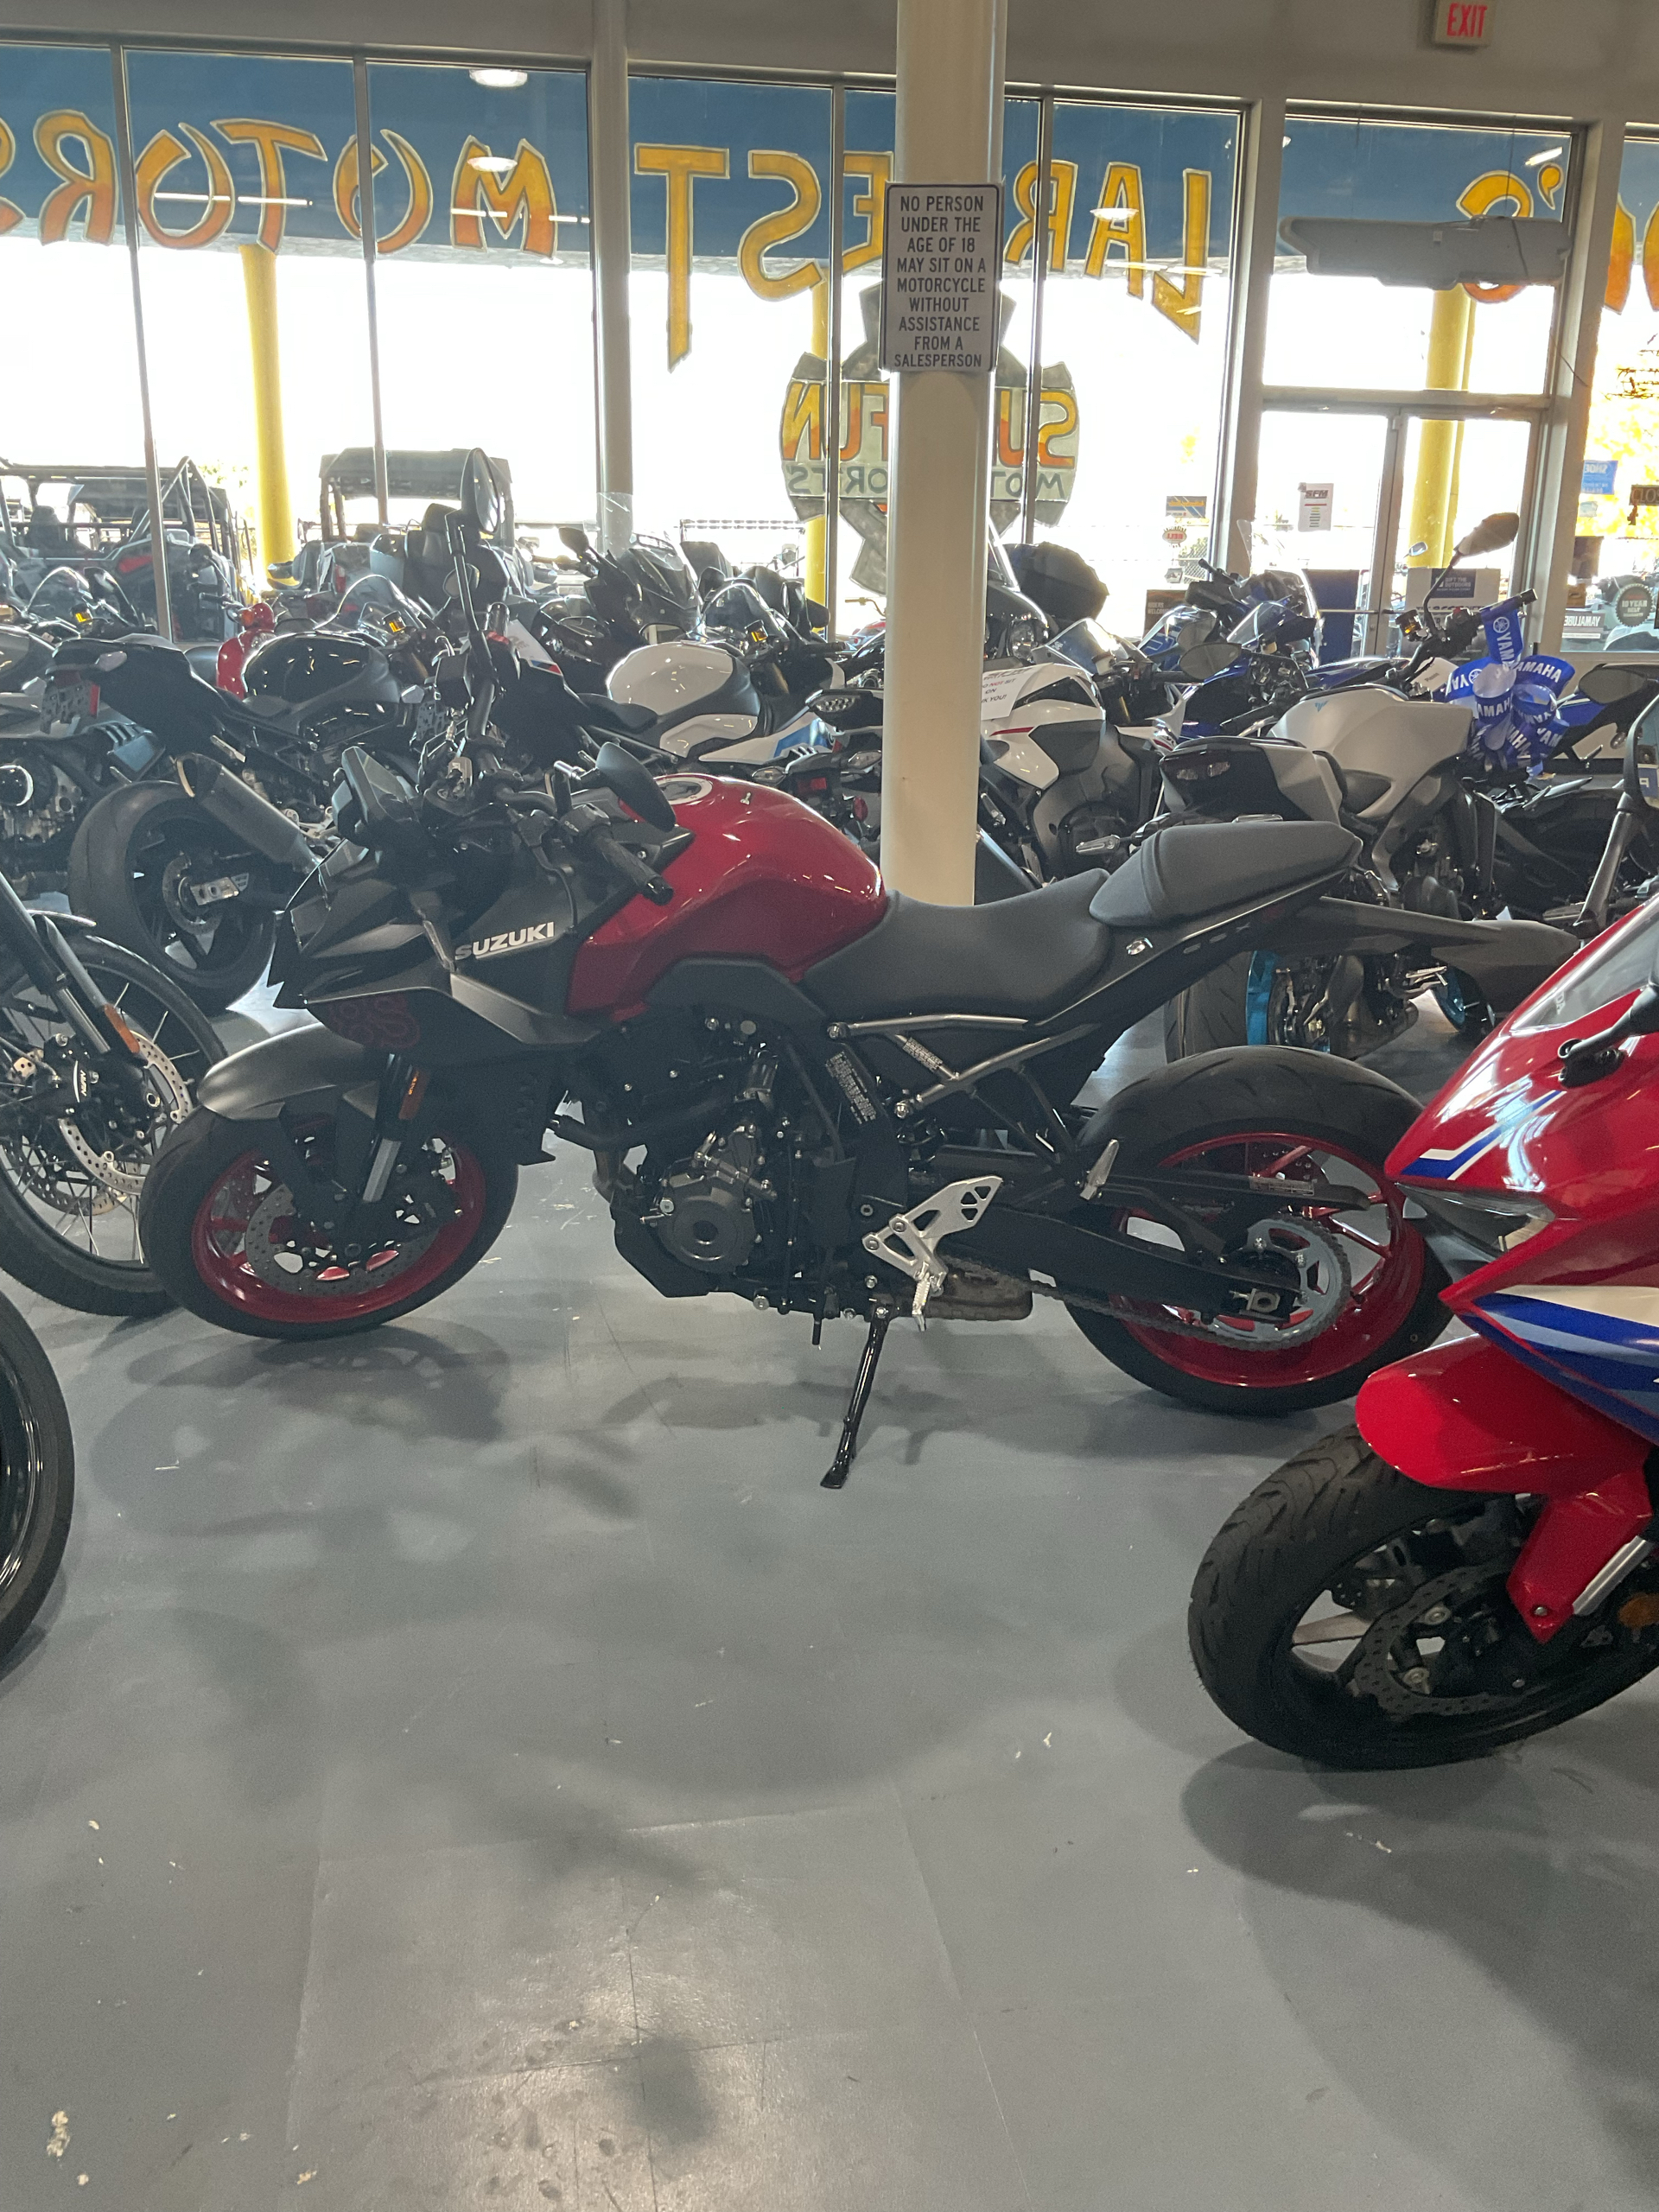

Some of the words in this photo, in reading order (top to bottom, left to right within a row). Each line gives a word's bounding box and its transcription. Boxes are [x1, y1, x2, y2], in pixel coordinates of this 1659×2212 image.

[1446, 3, 1488, 38] EXIT
[900, 195, 920, 212] NO
[926, 195, 984, 212] PERSON
[901, 217, 948, 232] UNDER
[955, 217, 981, 232] THE
[907, 237, 933, 253] AGE
[938, 237, 957, 252] OF
[962, 238, 976, 252] 18
[897, 257, 925, 273] MAY
[929, 257, 950, 273] SIT
[954, 257, 973, 273] ON
[977, 257, 986, 273] A
[897, 277, 985, 293] MOTORCYCLE
[909, 297, 969, 312] WITHOUT
[899, 316, 980, 331] ASSISTANCE
[914, 336, 950, 350] FROM
[955, 336, 963, 350] A
[894, 353, 982, 367] SALESPERSON
[454, 921, 555, 961] SUZUKI
